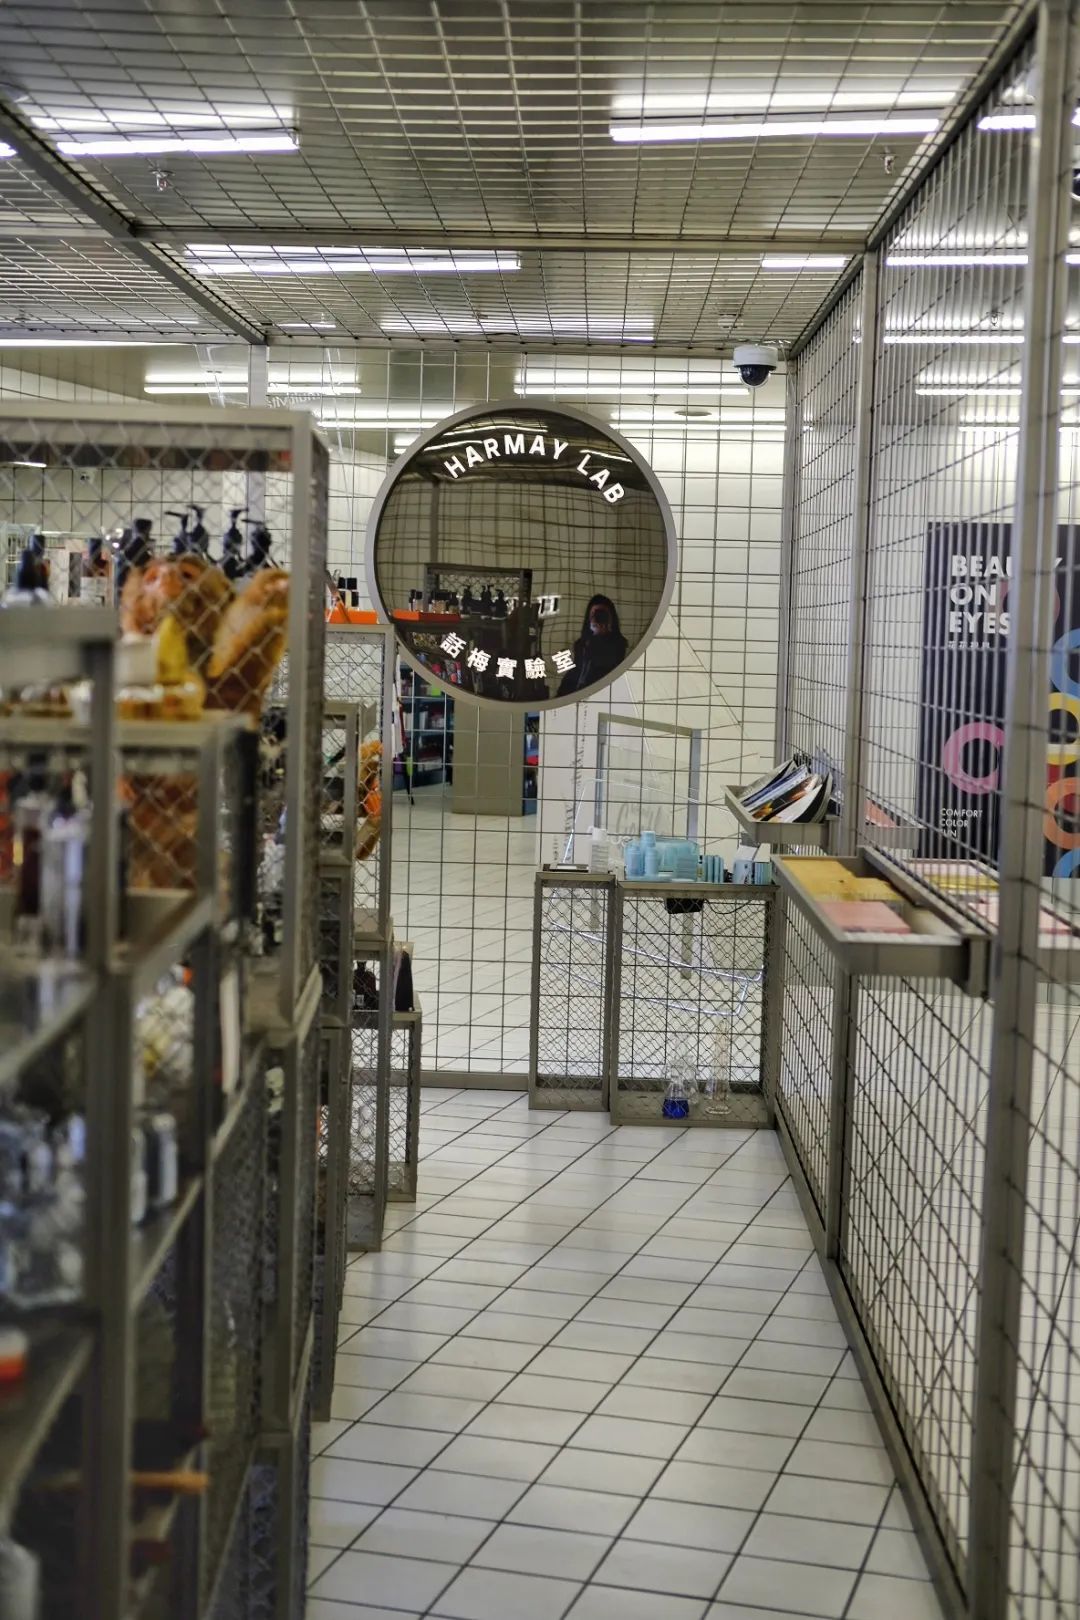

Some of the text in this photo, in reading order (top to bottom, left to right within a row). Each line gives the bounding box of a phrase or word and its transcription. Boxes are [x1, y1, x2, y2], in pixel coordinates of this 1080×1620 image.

[443, 433, 625, 504] HARMAY LAB
[950, 582, 997, 606] ON
[949, 611, 1012, 635] EYES
[439, 631, 577, 680] 話梅實驗室
[939, 818, 969, 828] COLOR
[940, 807, 983, 818] COMFORT
